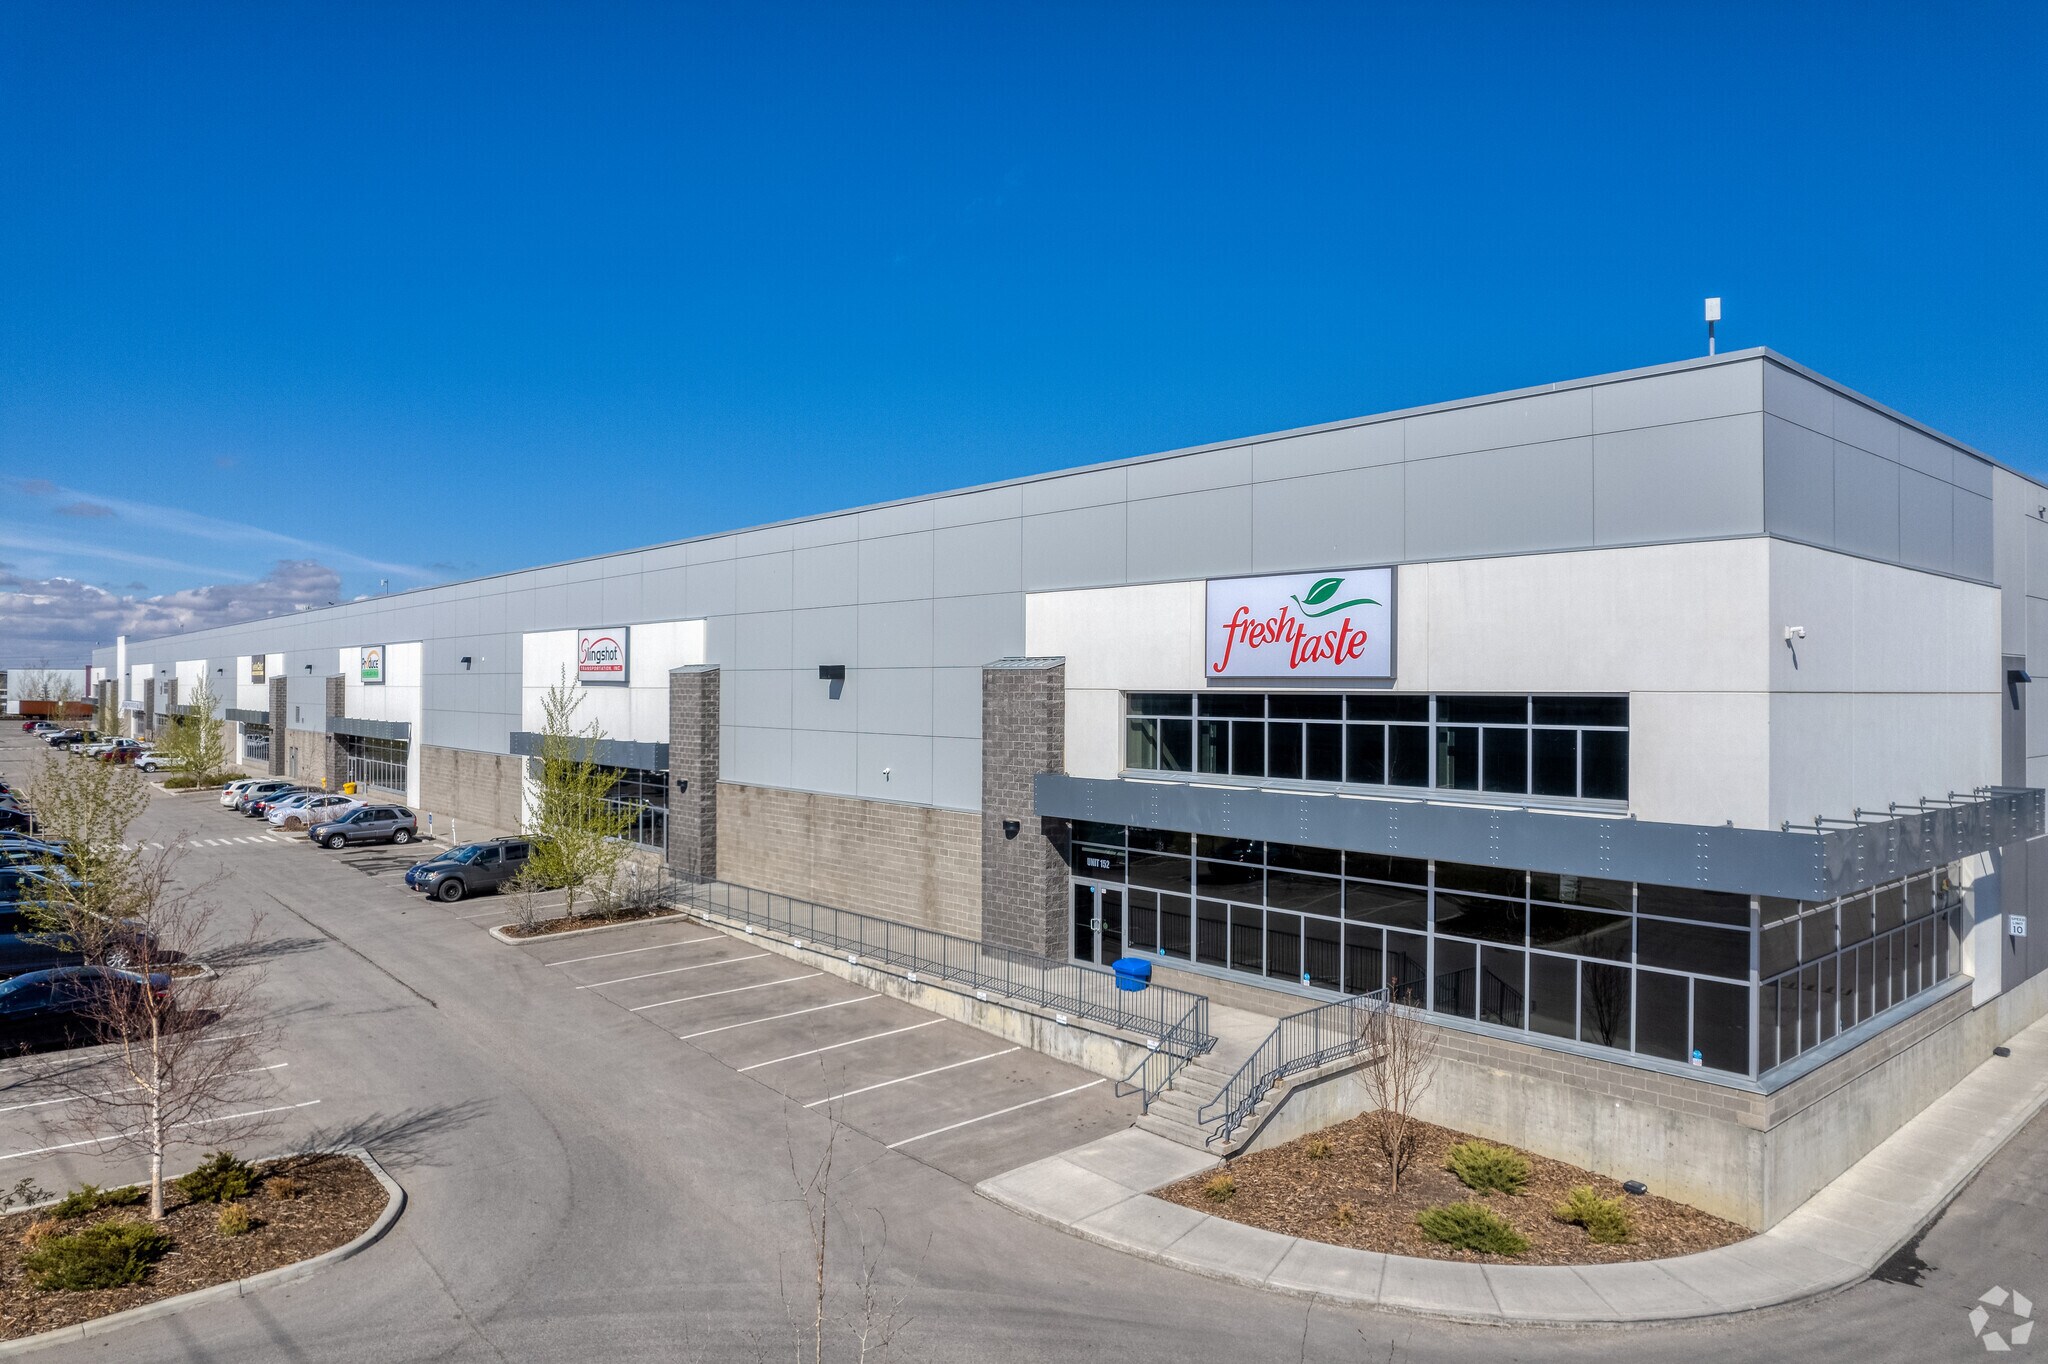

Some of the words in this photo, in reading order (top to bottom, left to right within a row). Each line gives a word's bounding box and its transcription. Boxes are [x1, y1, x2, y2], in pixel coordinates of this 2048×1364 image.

[580, 638, 618, 664] Slingshot
[1212, 606, 1296, 673] fresh
[1290, 617, 1368, 670] taste
[1087, 857, 1099, 867] UNIT
[1100, 859, 1110, 869] 152
[2013, 926, 2023, 934] 10
